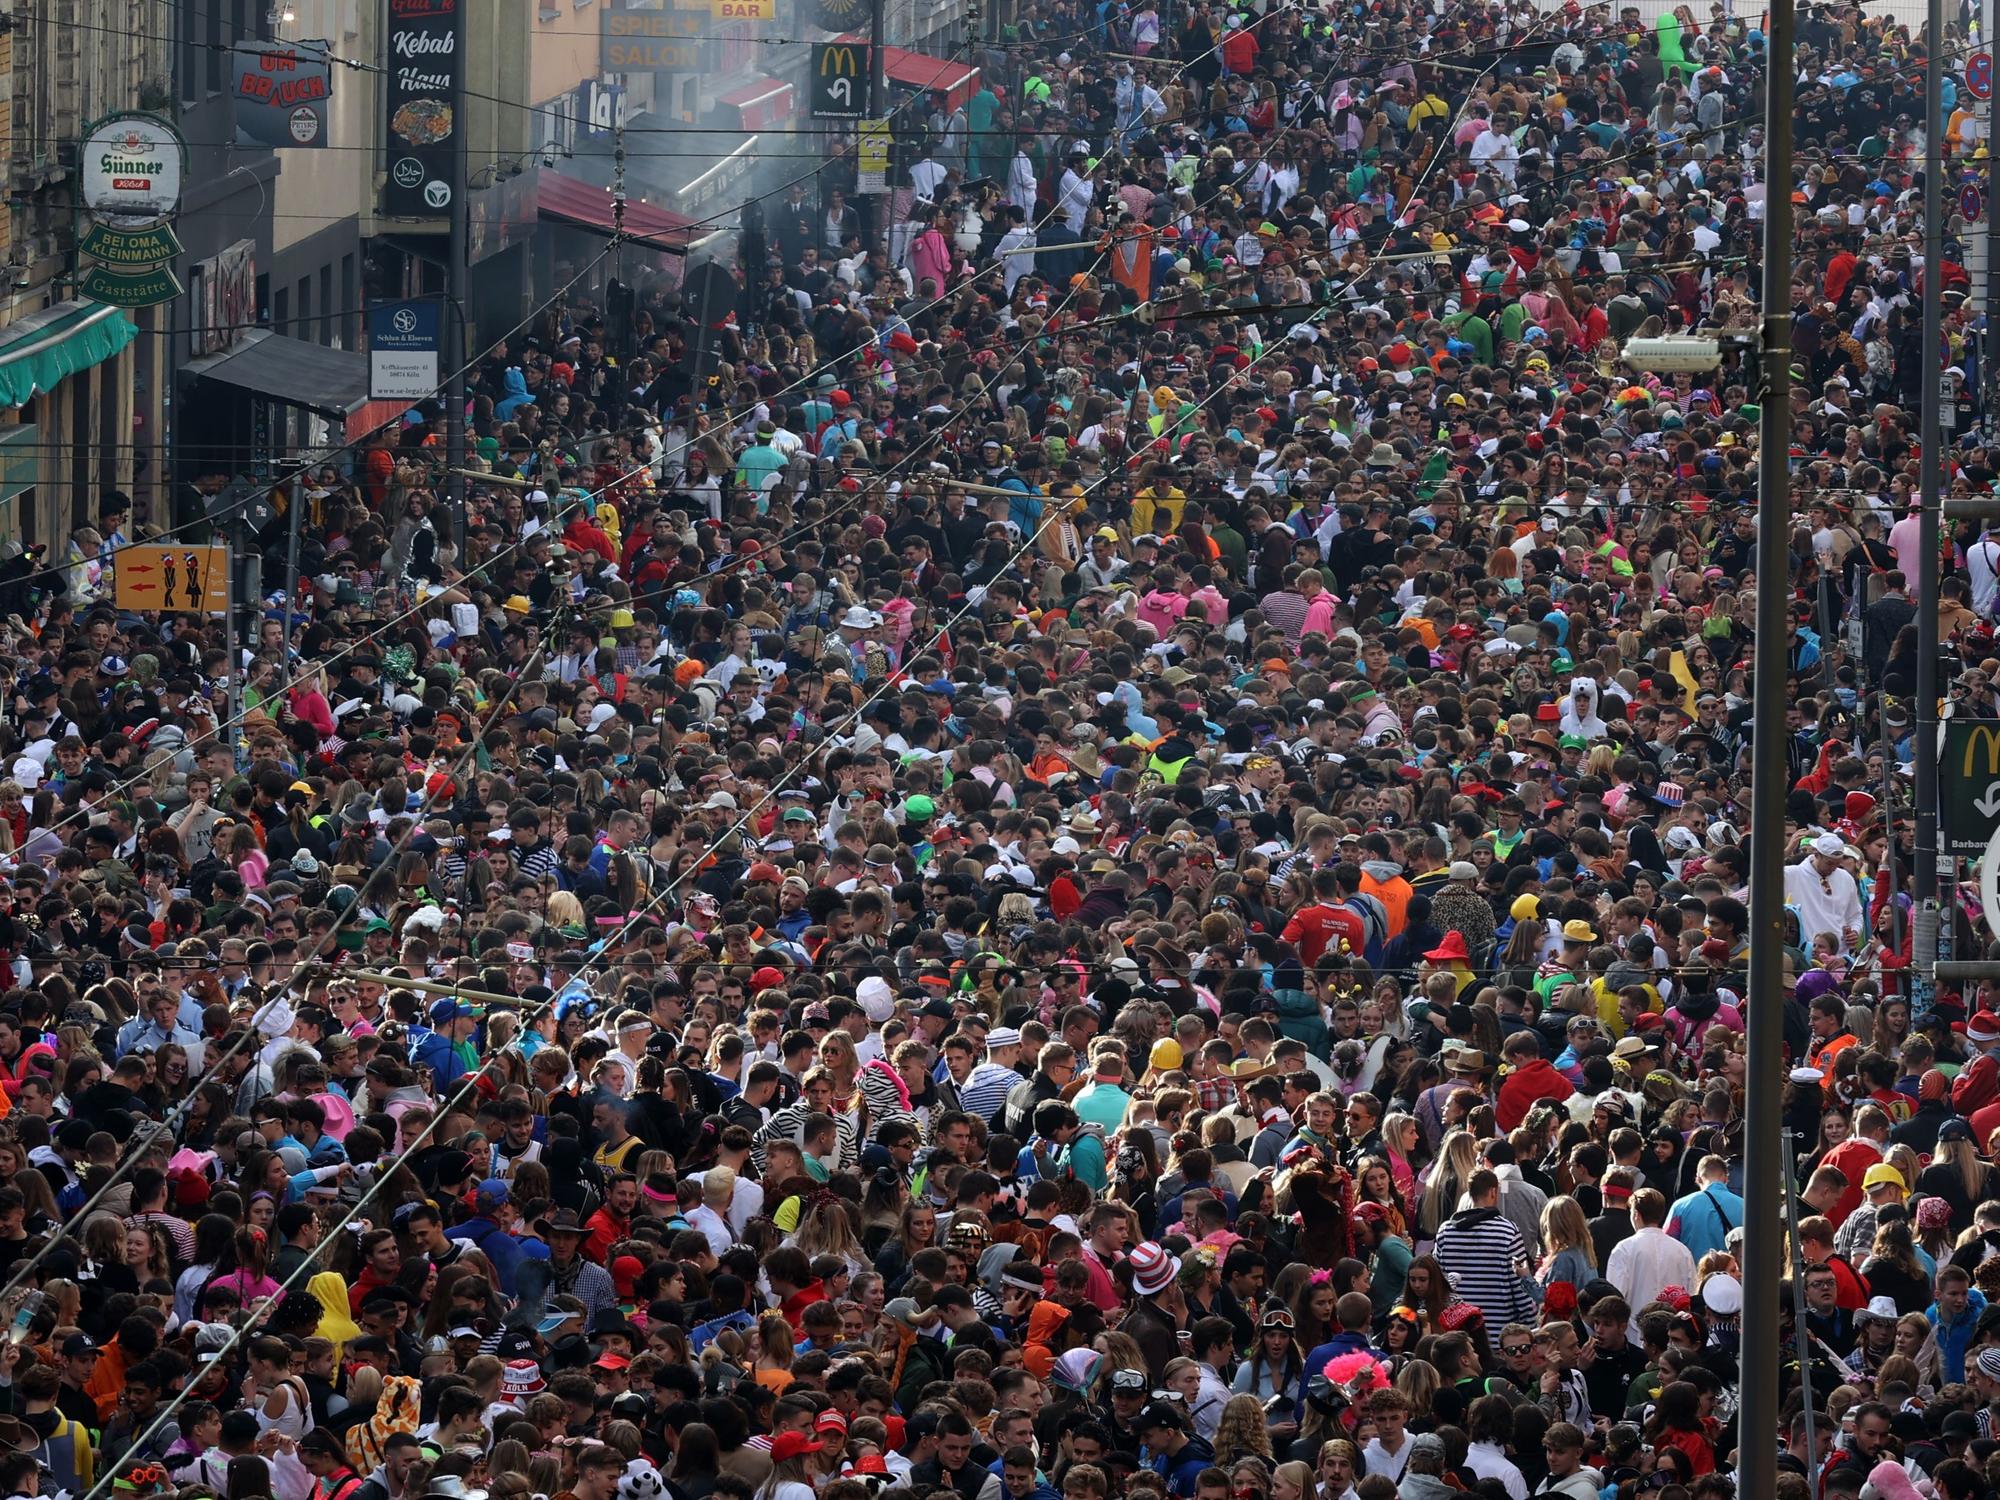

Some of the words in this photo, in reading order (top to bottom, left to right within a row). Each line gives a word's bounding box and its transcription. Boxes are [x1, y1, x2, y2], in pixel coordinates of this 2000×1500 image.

[722, 4, 760, 17] BAR
[610, 15, 680, 36] SPIEL
[393, 30, 455, 58] Kebab
[260, 50, 296, 72] UM
[609, 45, 697, 66] SALON
[397, 67, 451, 91] Haus
[240, 72, 325, 108] BRAUCH
[100, 153, 163, 175] Sünner
[91, 242, 171, 261] KLEINMANN
[102, 233, 124, 248] BEI
[129, 235, 161, 249] OMA
[92, 278, 168, 297] Gaststätte
[1951, 839, 1989, 849] Barbaro
